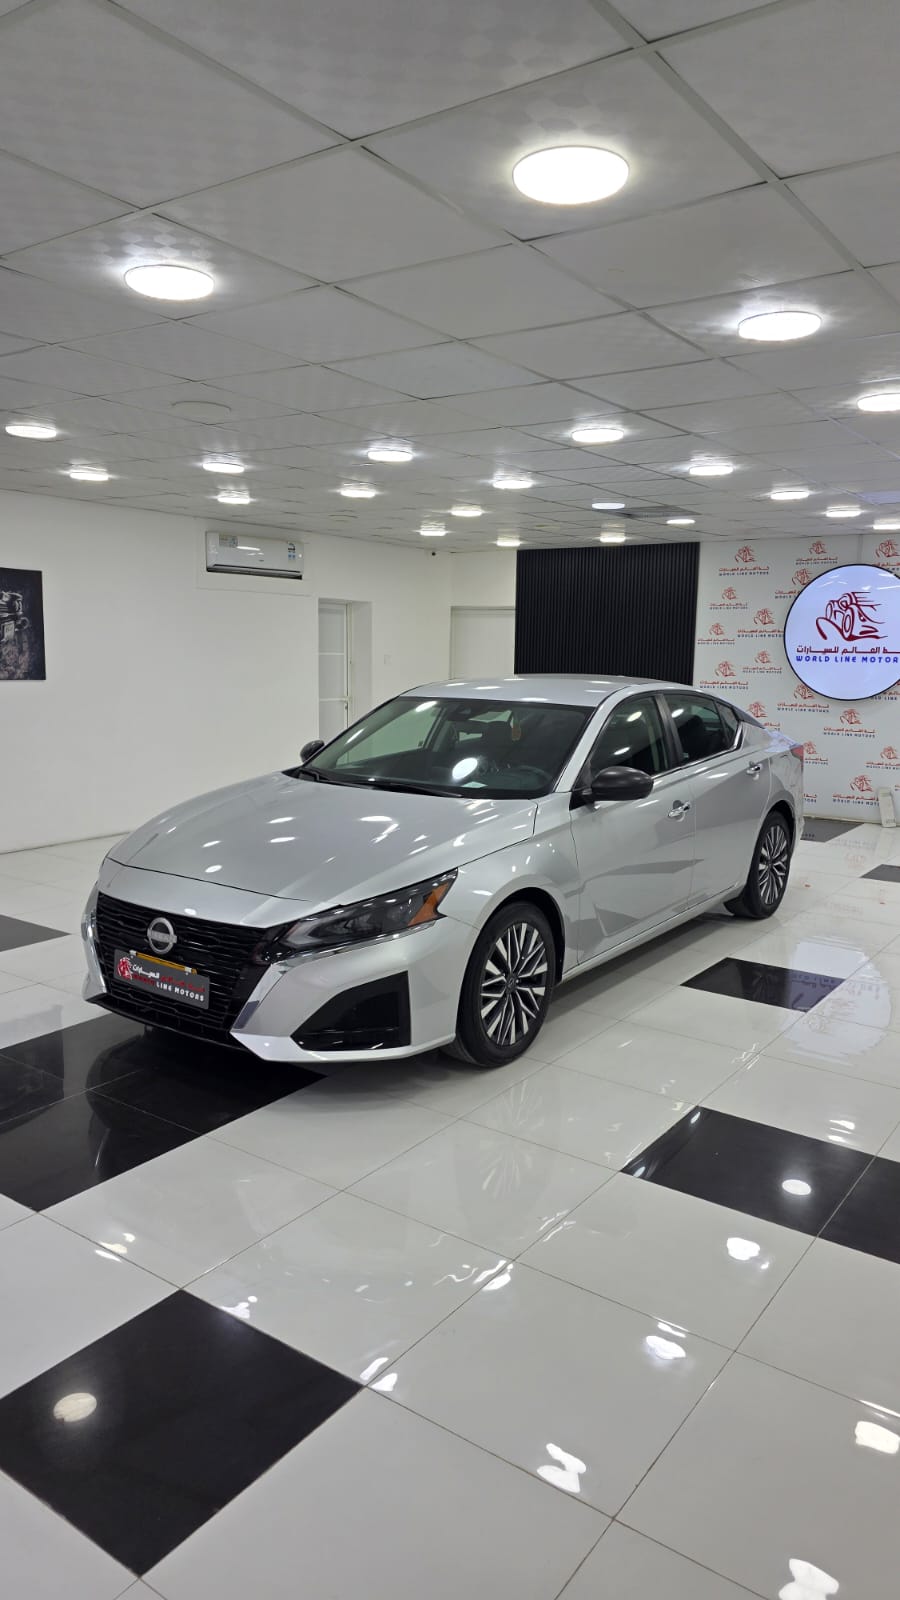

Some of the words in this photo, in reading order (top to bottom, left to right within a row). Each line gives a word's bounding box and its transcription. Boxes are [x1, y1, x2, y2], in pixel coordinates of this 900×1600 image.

[796, 645, 839, 655] للسيارات
[842, 646, 881, 655] العالم
[861, 656, 899, 664] MOTOR
[156, 981, 172, 991] LINE
[174, 987, 204, 1002] MOTORS
